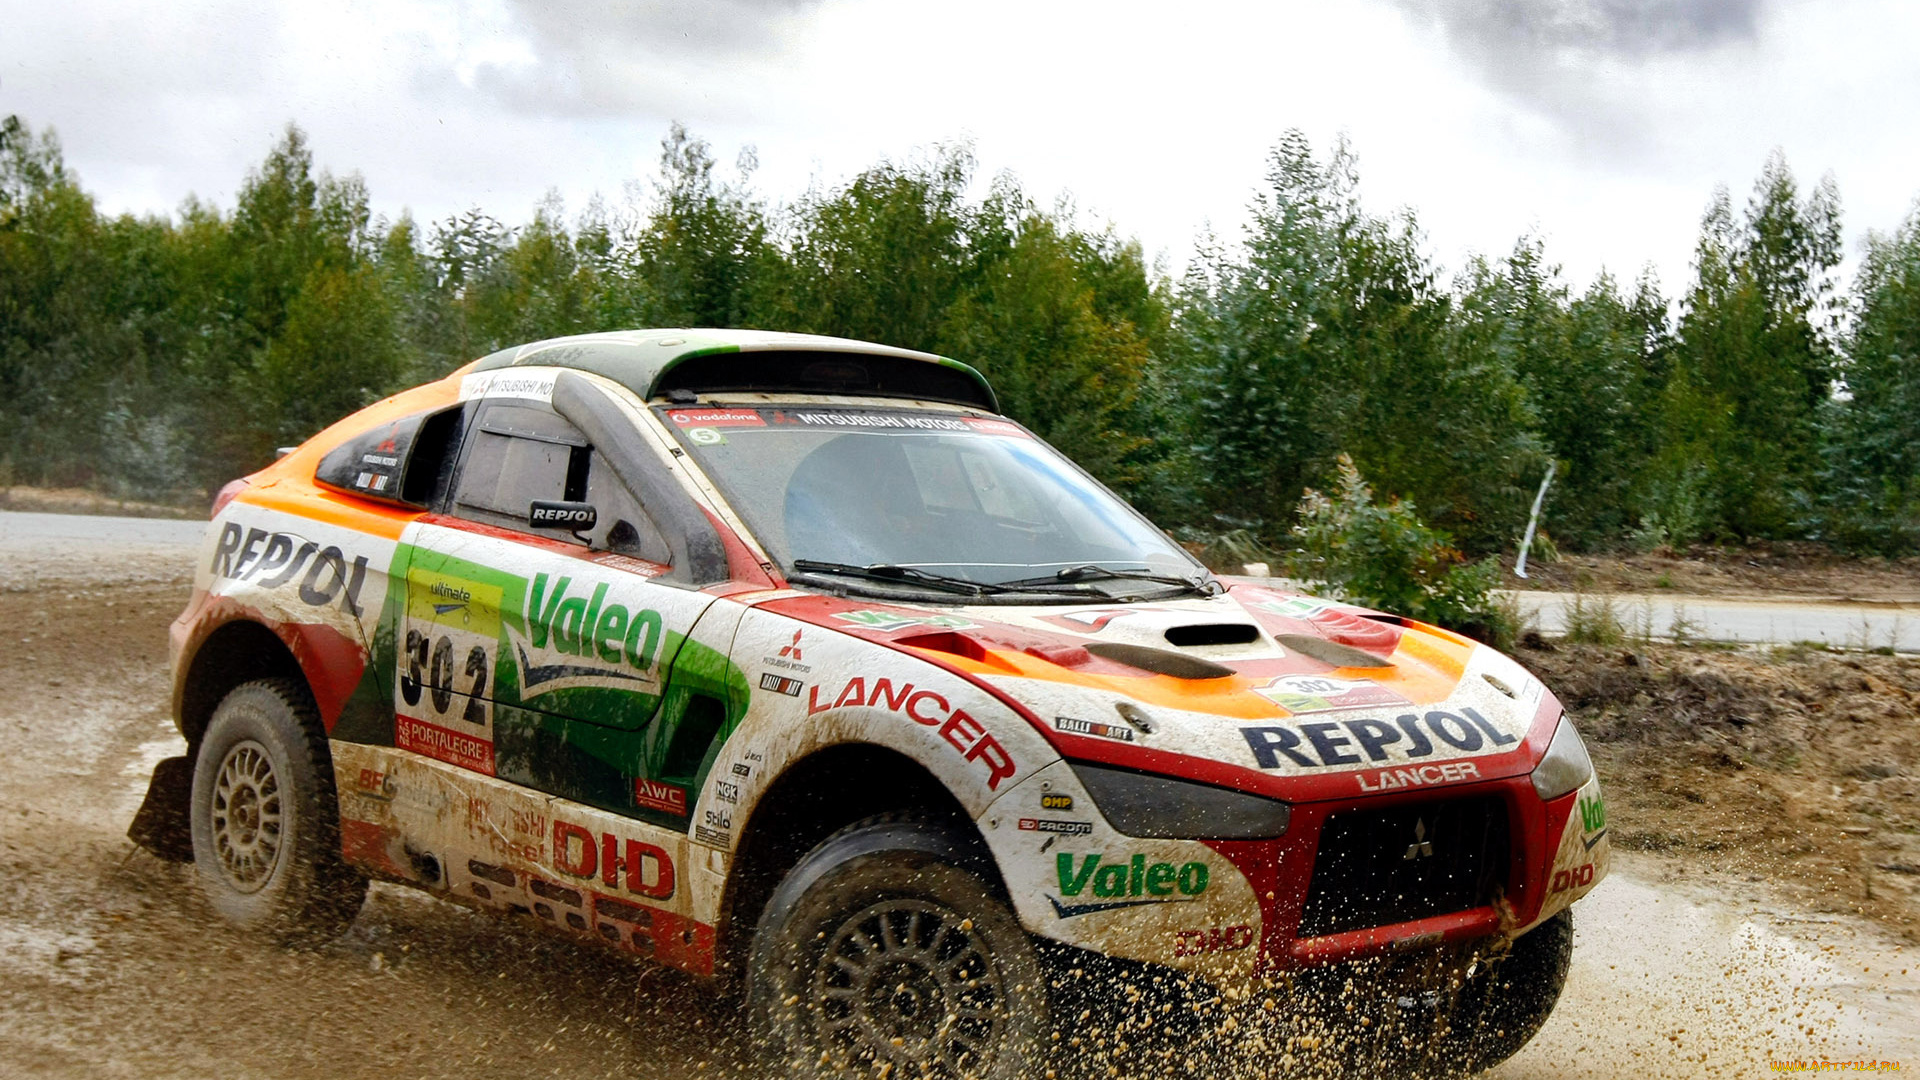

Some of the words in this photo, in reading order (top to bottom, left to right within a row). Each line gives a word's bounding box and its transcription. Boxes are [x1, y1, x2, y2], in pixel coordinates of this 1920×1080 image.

[693, 413, 757, 421] vodafone
[797, 413, 903, 428] MITSUBISHI
[902, 417, 970, 431] MOTORS
[533, 508, 596, 522] REPSOL
[210, 522, 368, 618] REPSOL
[430, 581, 471, 603] ultimate
[528, 572, 662, 670] Valeo
[1286, 680, 1344, 693] 302
[412, 723, 483, 759] PORTALEGRE
[808, 677, 1016, 791] LANCER
[1239, 707, 1516, 769] REPSOL
[1356, 762, 1481, 792] LANCER
[640, 780, 680, 804] AWC
[717, 782, 737, 799] NGK
[1043, 796, 1072, 808] OMP
[1039, 821, 1091, 833] FACOM
[1057, 853, 1209, 897] Valeo
